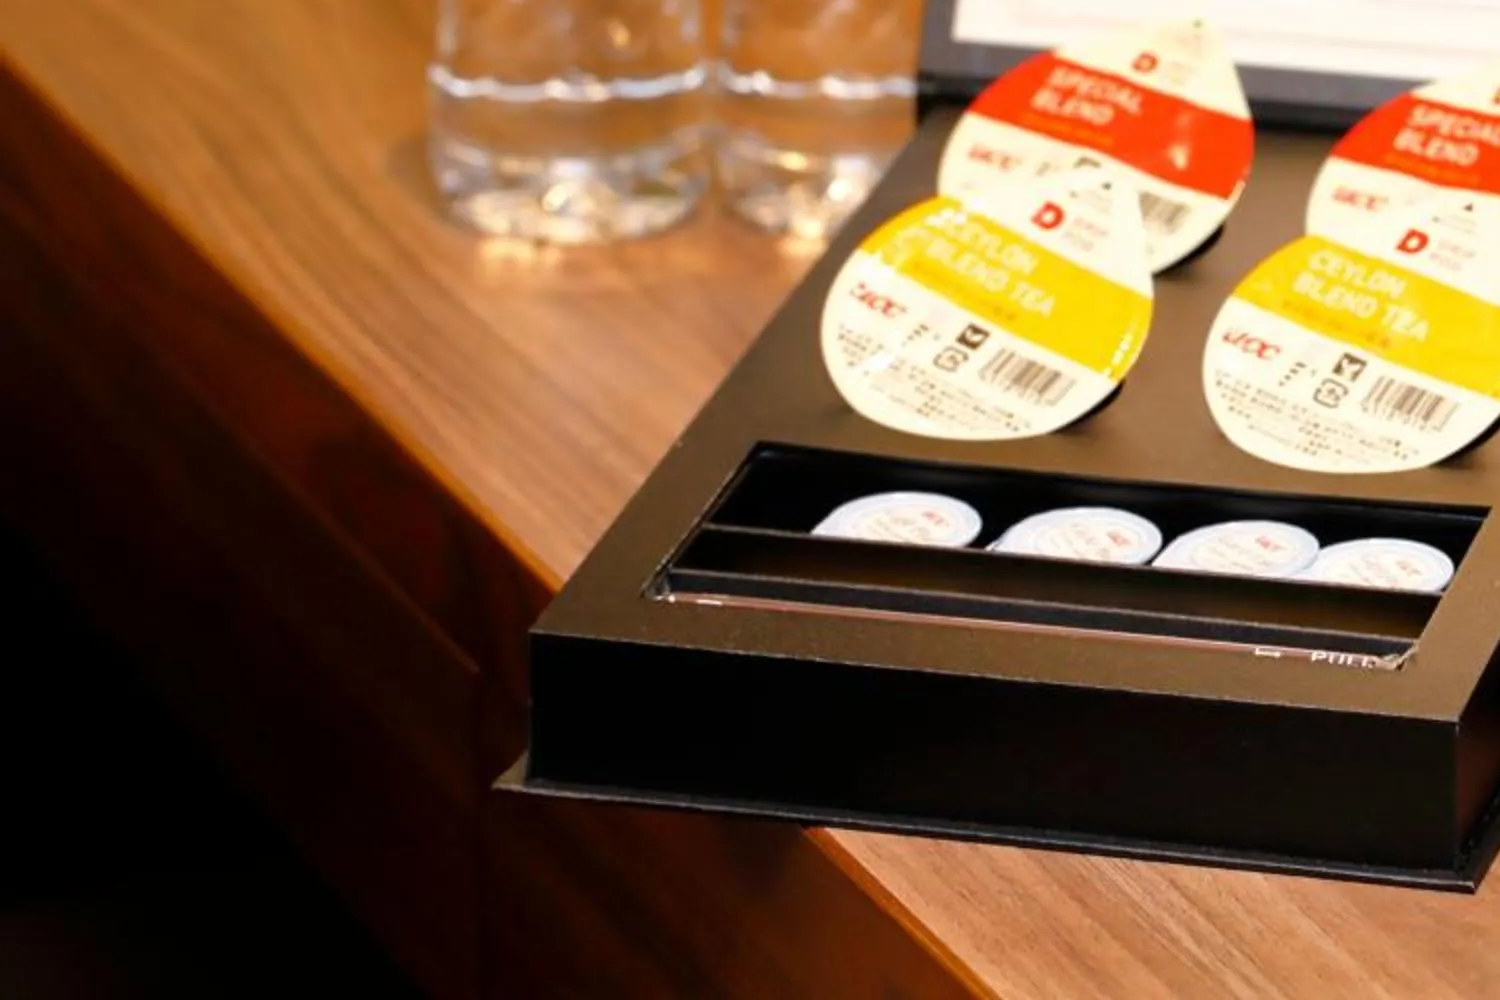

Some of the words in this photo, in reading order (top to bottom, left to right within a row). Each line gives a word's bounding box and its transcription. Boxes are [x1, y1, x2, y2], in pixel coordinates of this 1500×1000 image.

[1309, 250, 1408, 299] CEYLON
[1293, 272, 1378, 320] BLEND
[1381, 302, 1429, 341] TEA
